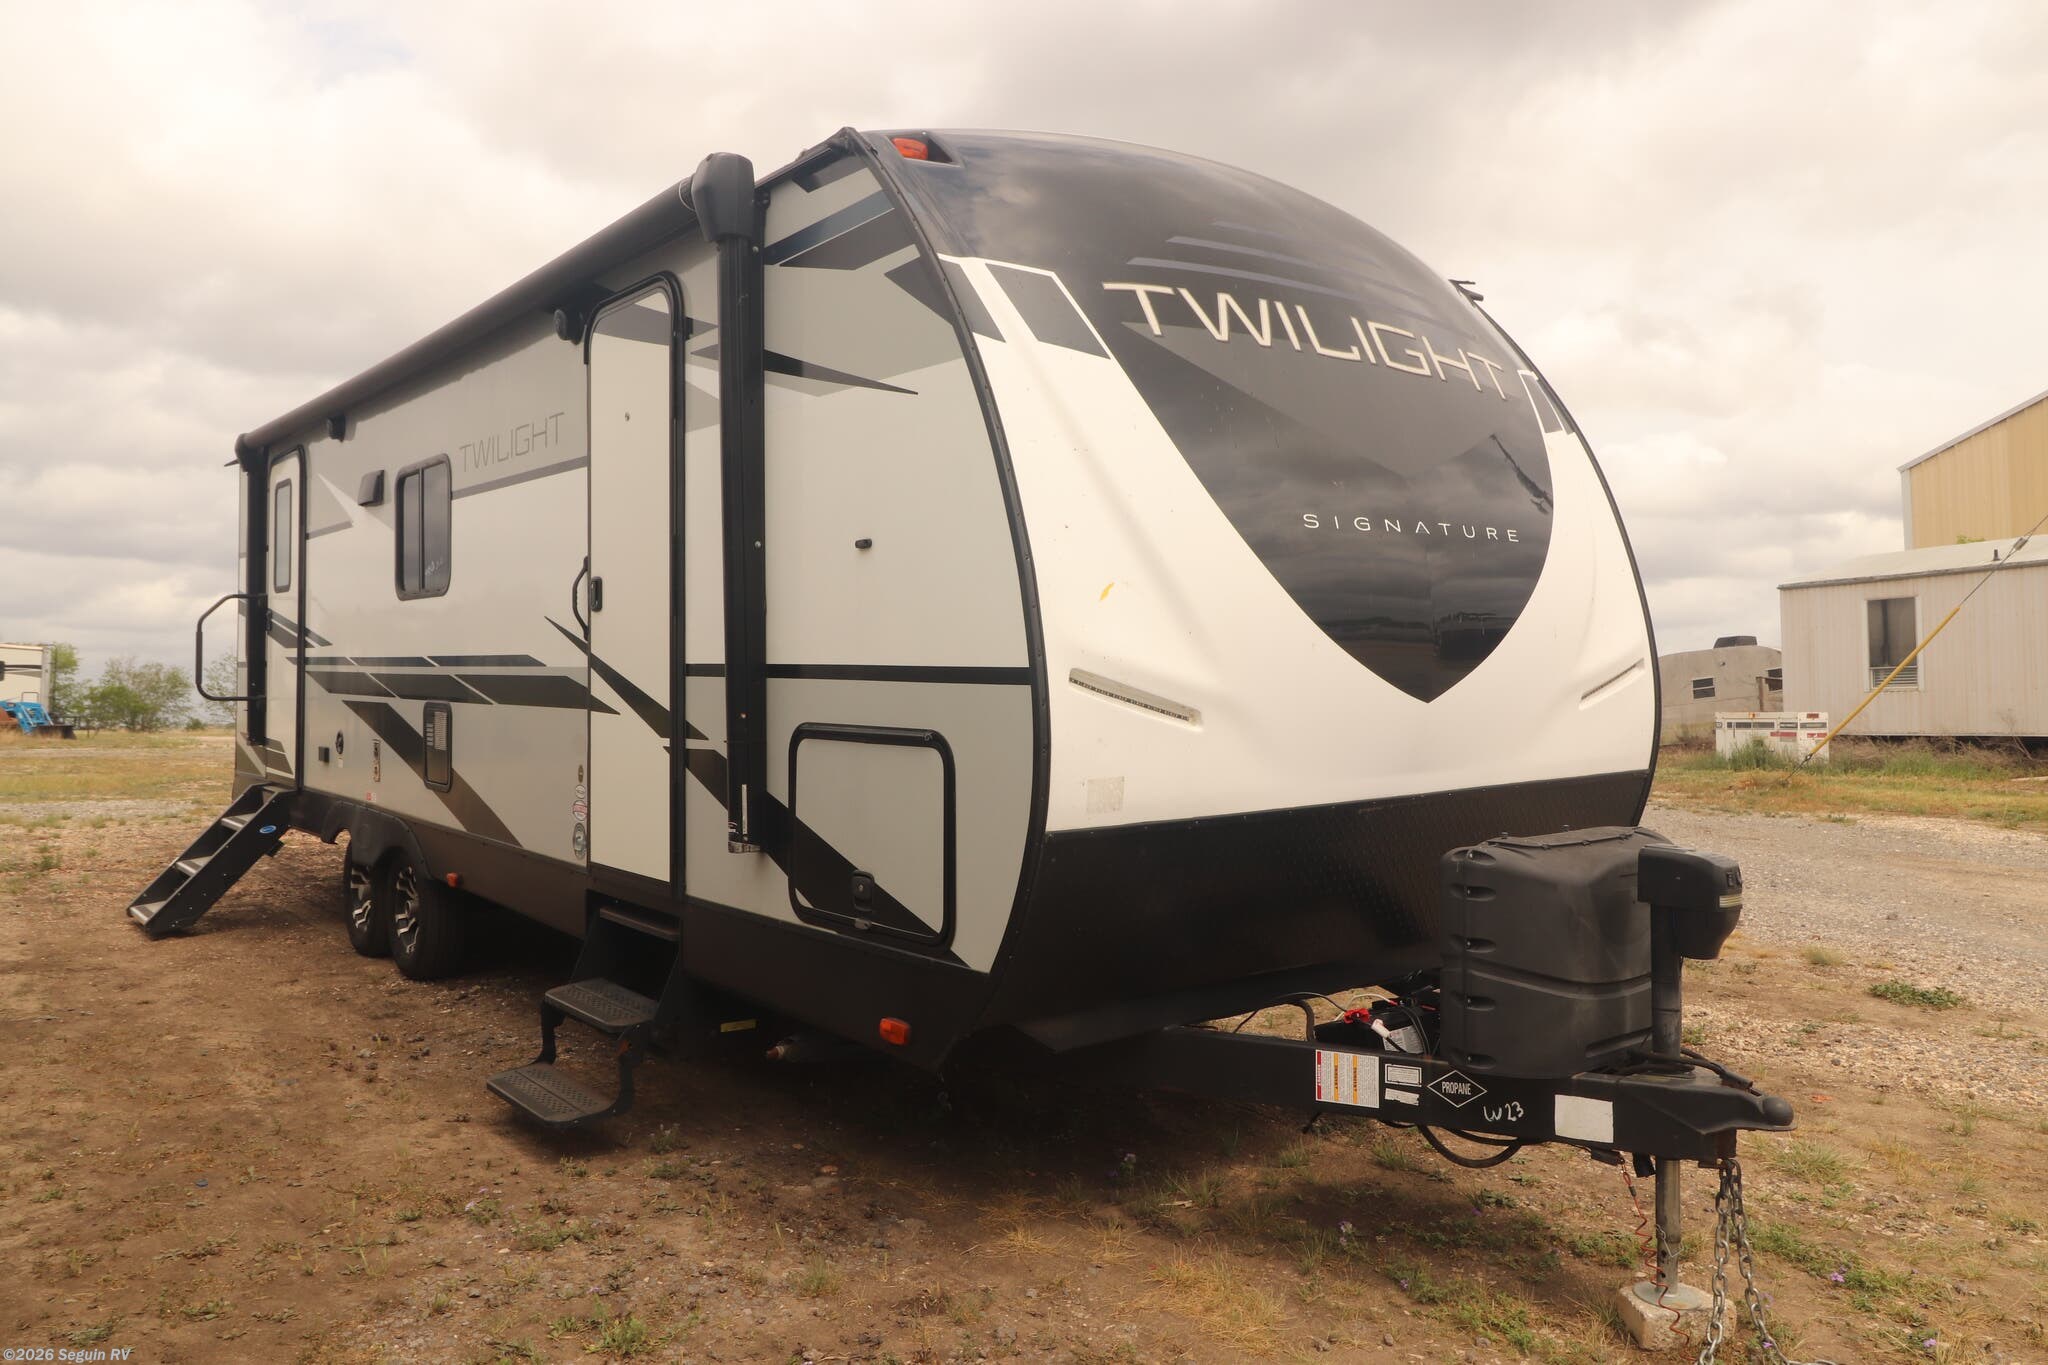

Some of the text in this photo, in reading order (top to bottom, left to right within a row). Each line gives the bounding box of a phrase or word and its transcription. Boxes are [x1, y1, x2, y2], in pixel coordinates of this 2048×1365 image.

[1103, 281, 1508, 400] TWILIGHT
[459, 411, 566, 472] TWILIGHT
[1303, 513, 1520, 543] SIGNATURE
[1441, 1081, 1472, 1096] PROPANE
